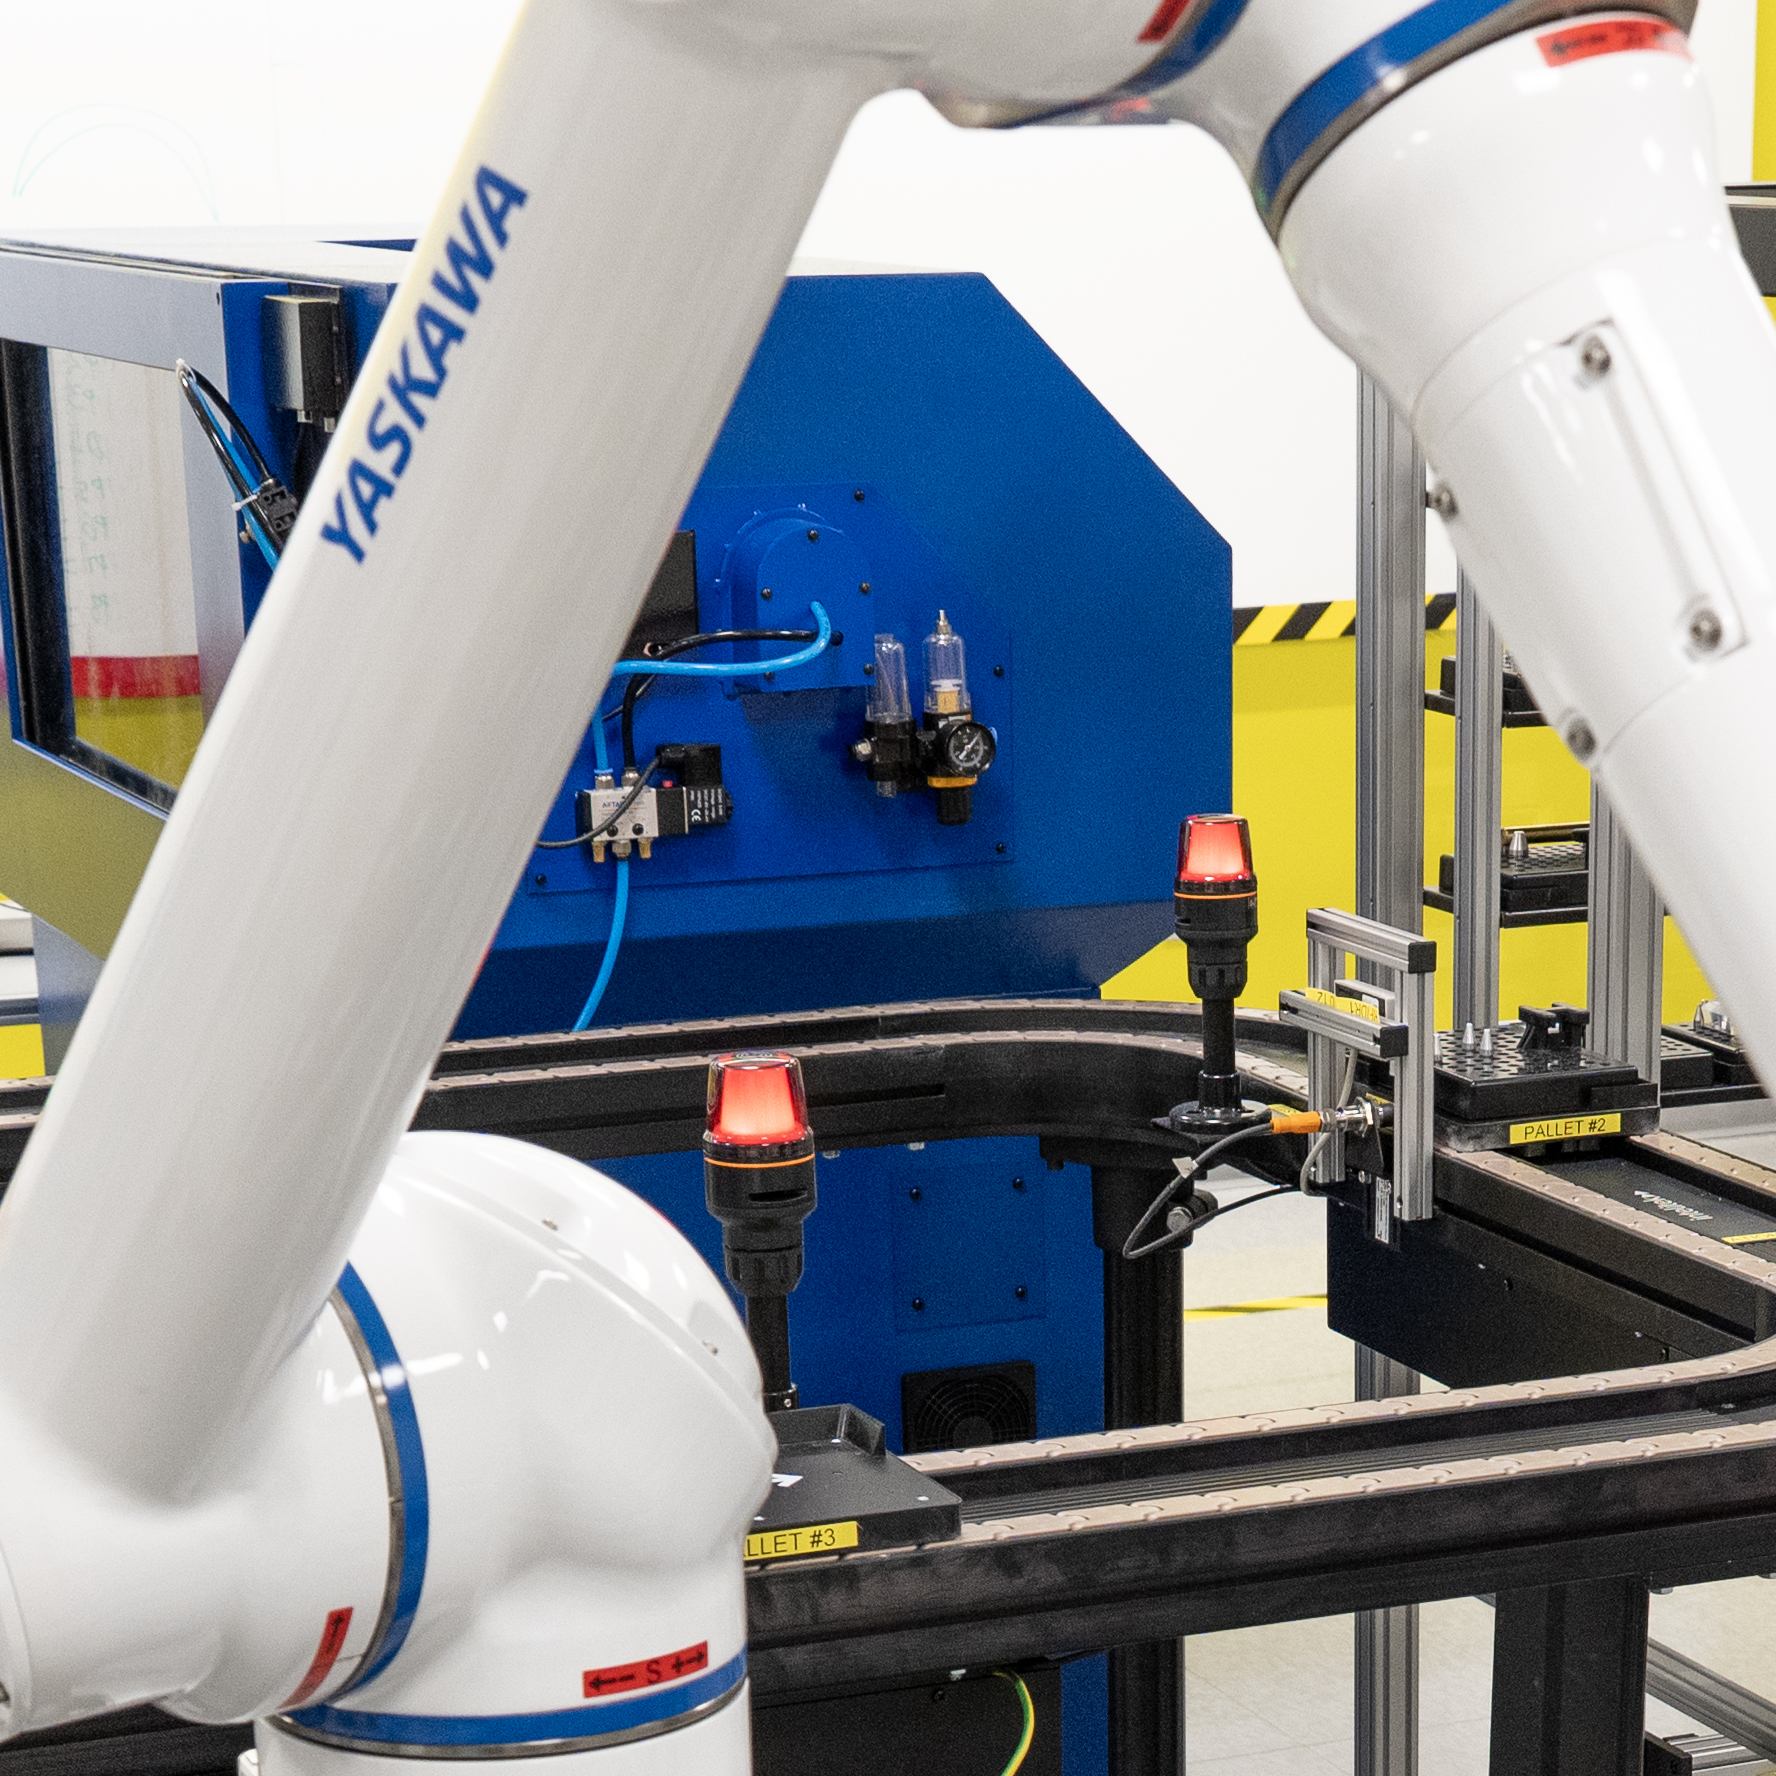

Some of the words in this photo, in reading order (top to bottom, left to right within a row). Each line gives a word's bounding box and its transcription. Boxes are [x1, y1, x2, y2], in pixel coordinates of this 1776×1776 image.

[323, 163, 529, 565] YASKAWA
[1524, 1120, 1585, 1140] PALLET
[1589, 1117, 1606, 1132] #2
[745, 1534, 799, 1558] LLET
[809, 1529, 836, 1549] #3
[647, 1652, 662, 1680] S
